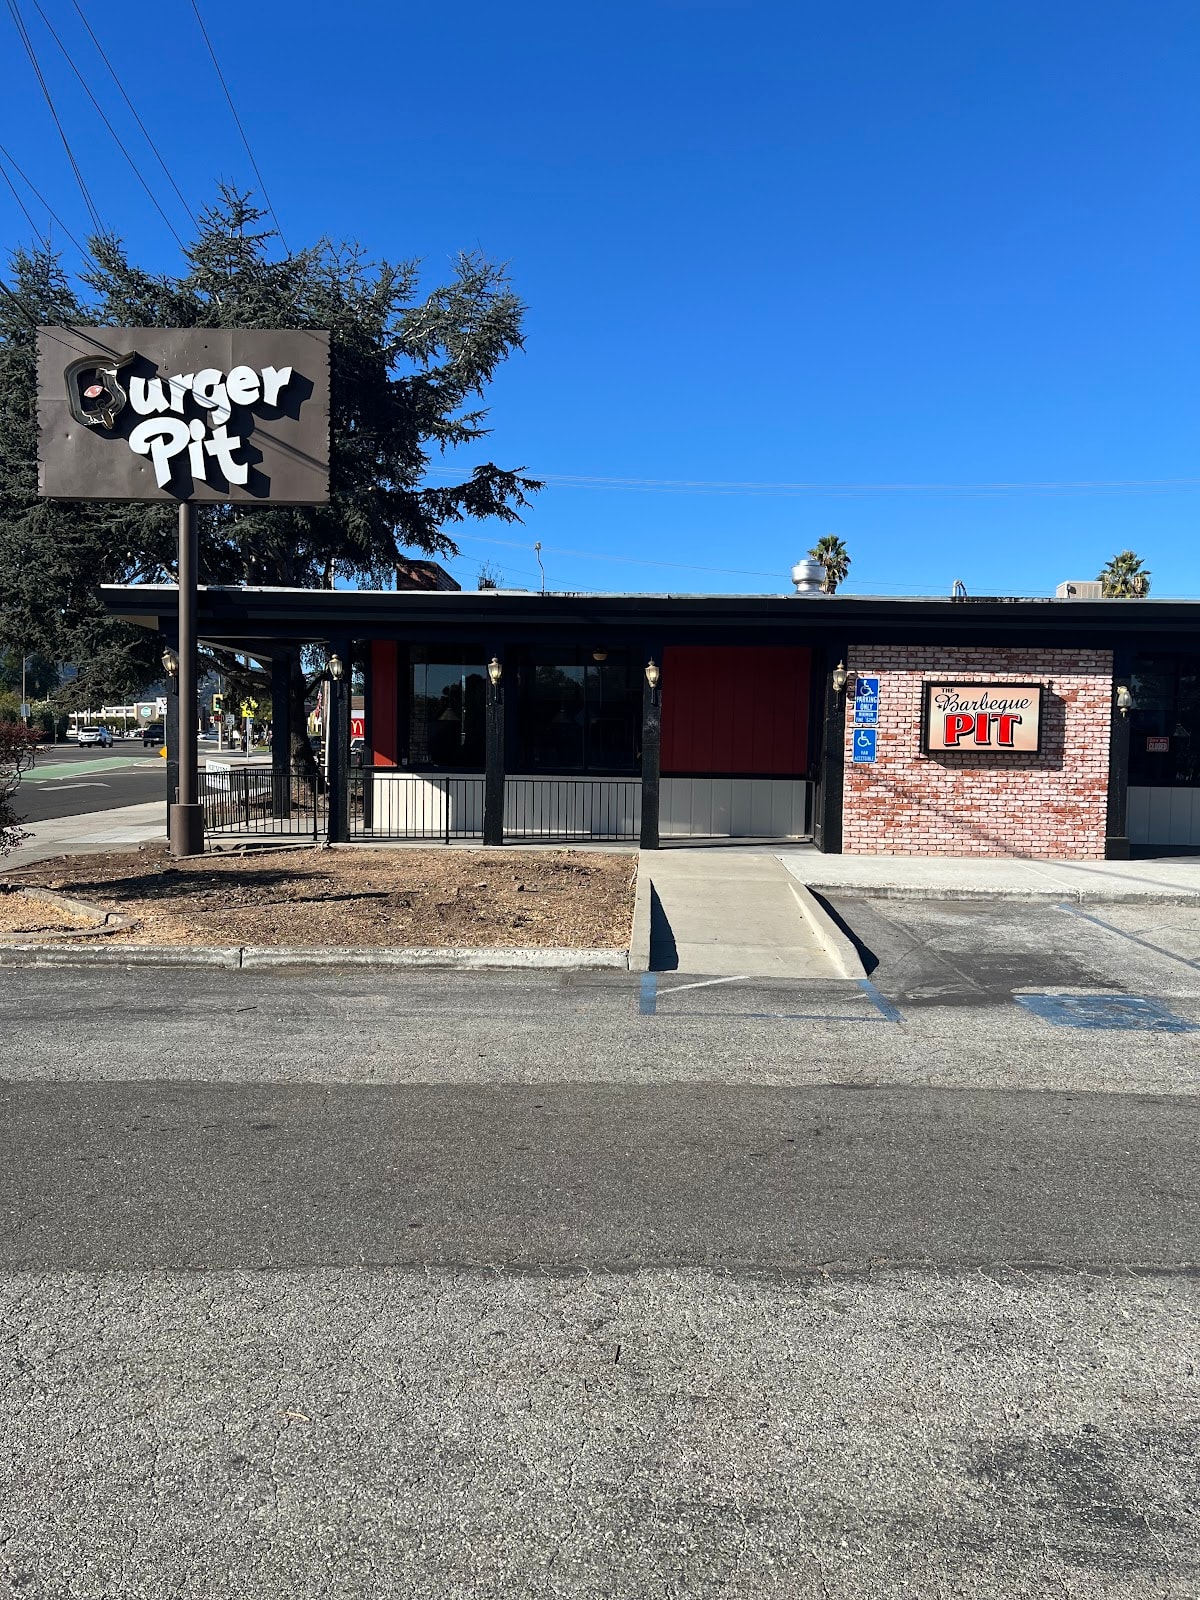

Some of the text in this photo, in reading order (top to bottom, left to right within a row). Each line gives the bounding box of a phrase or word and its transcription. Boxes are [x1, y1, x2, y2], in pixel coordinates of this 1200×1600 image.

[64, 350, 293, 429] Burger
[129, 416, 249, 489] Pit
[856, 696, 878, 704] PARKING
[935, 691, 1032, 714] Barbeque
[943, 712, 1023, 747] PIT
[1148, 742, 1168, 750] CLOSED
